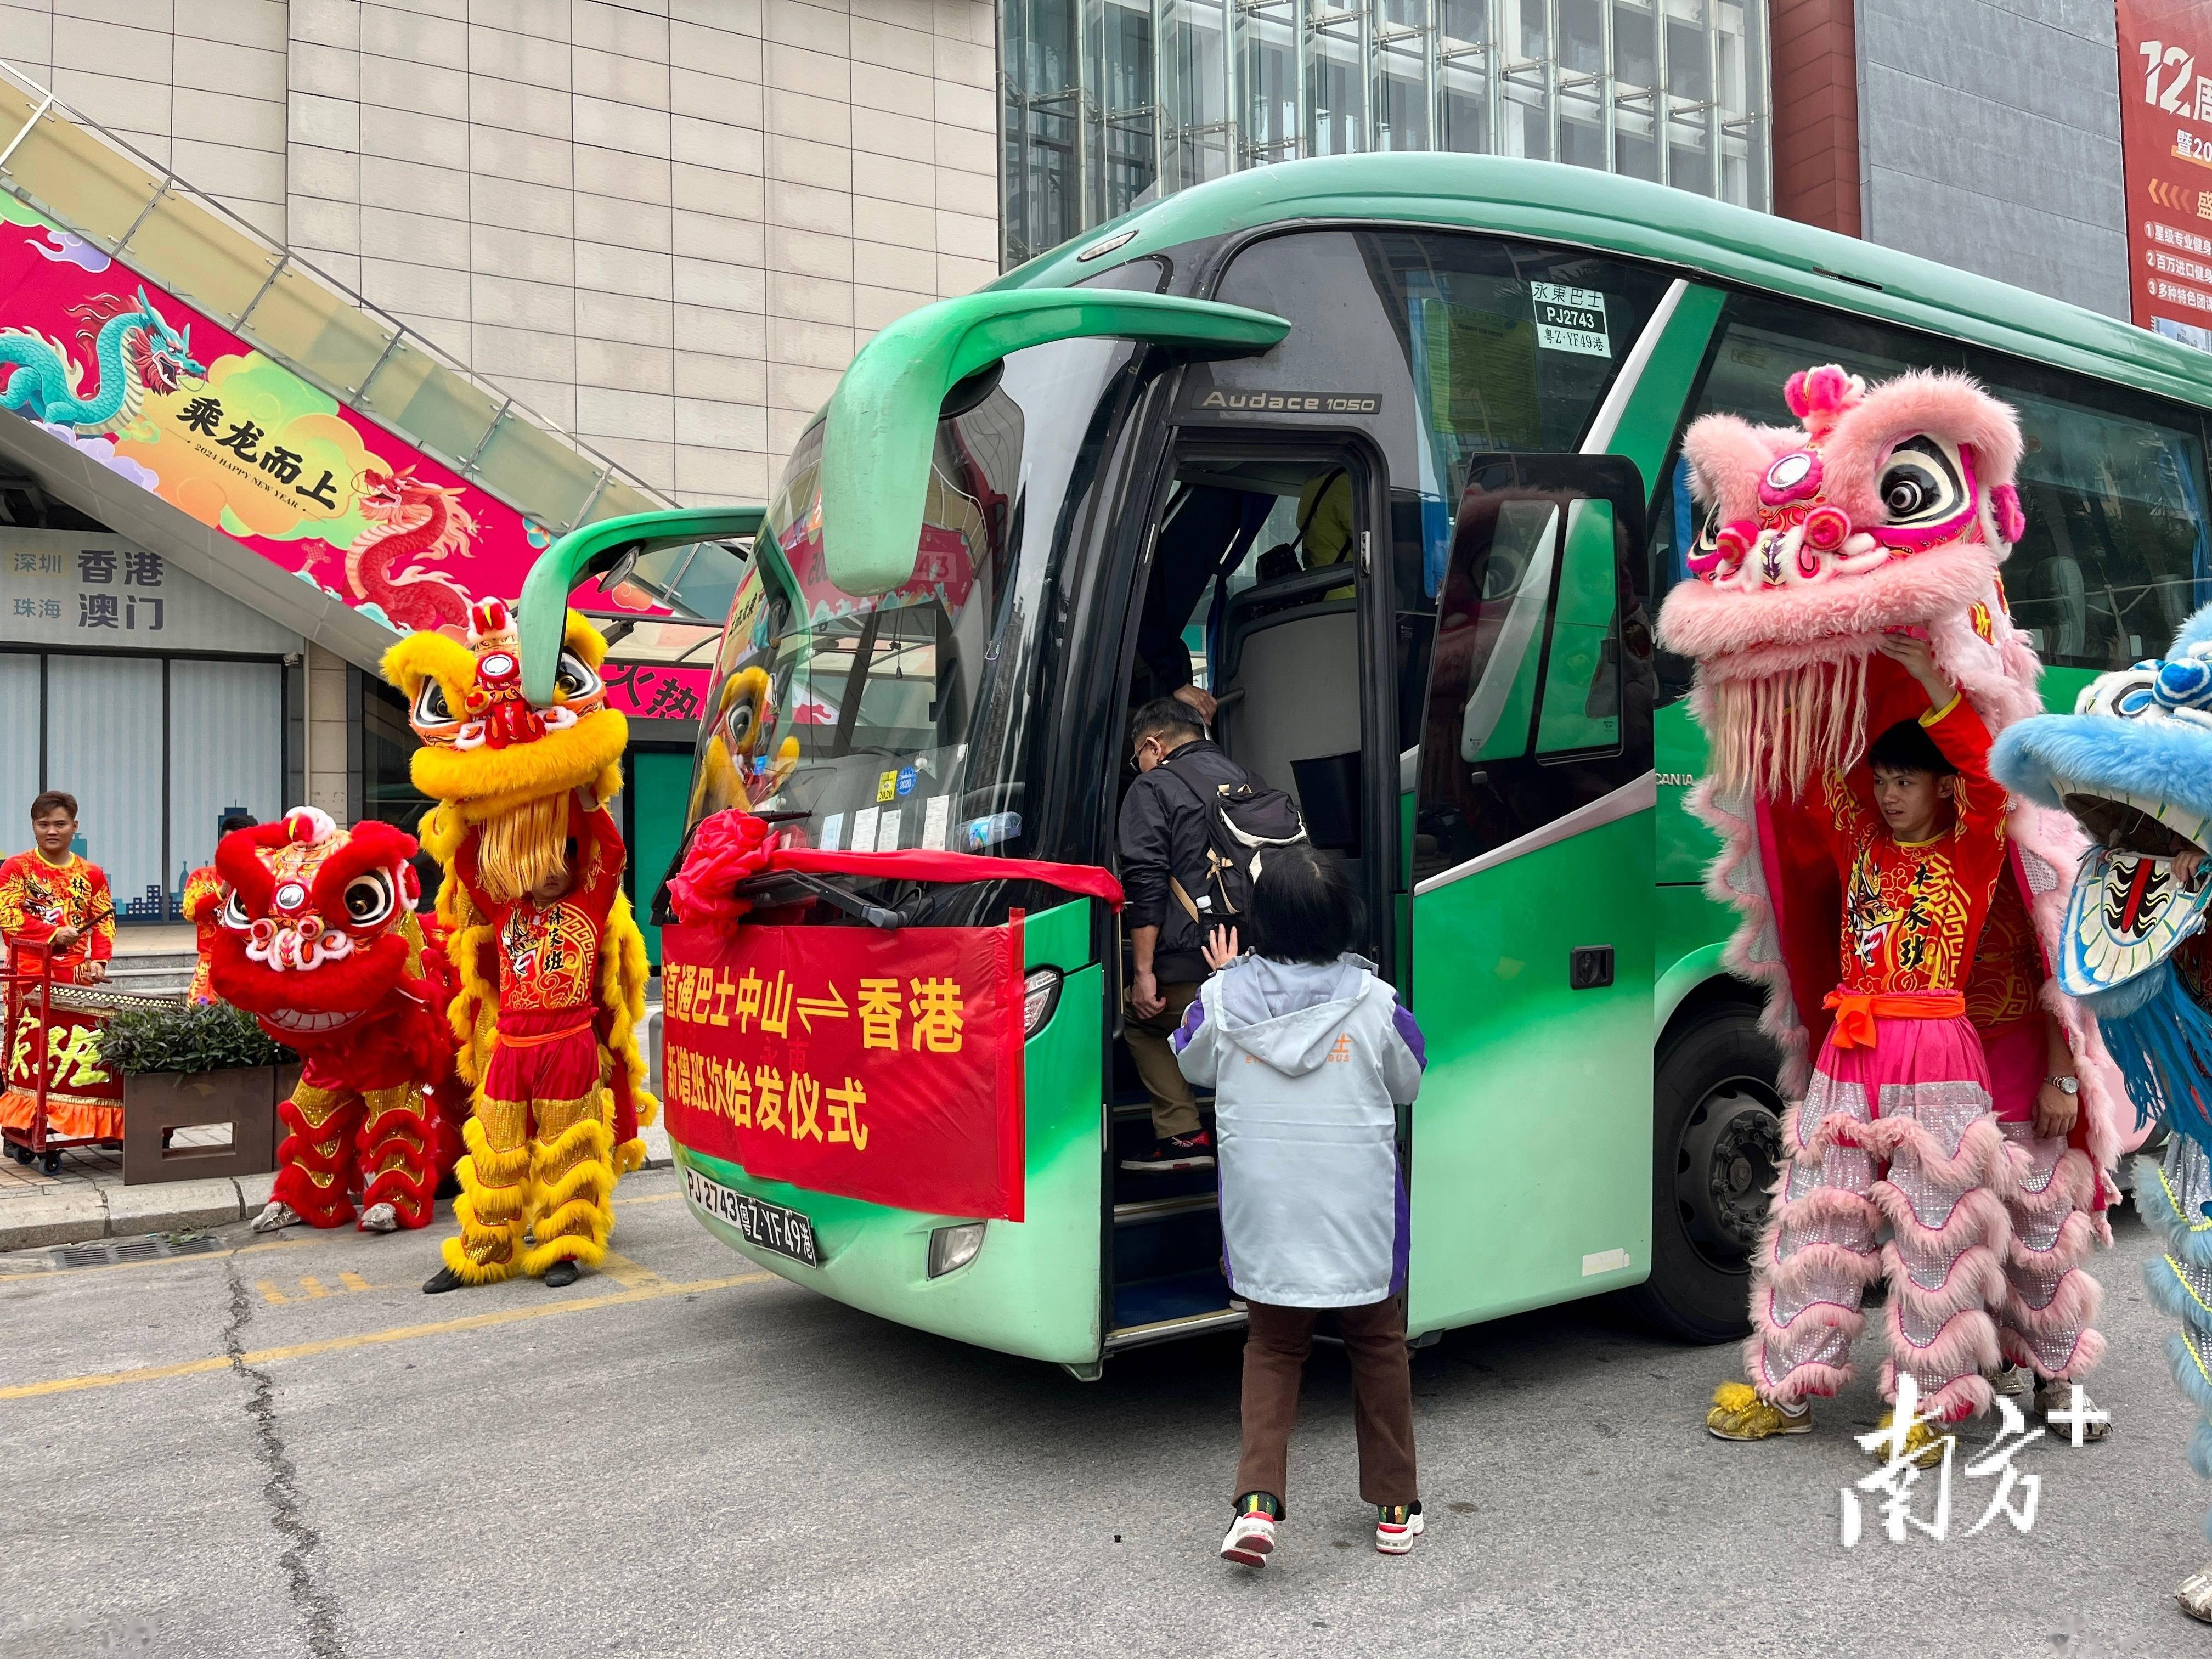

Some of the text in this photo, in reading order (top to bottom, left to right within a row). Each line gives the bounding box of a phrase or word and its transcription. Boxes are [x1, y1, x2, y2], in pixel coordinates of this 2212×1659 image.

[2155, 224, 2211, 256] 星级专业健身
[2156, 253, 2212, 284] 百万进口健身
[1534, 284, 1601, 308] 永東巴士
[1547, 306, 1595, 329] PJ2743
[1544, 328, 1604, 351] 粤Z·YF49港
[1202, 391, 1375, 411] Audace 1050
[176, 397, 337, 510] 乘龙而上
[194, 444, 298, 509] 2024 HAPPY NEW YEAR
[14, 549, 163, 586] 深圳 香港
[13, 593, 163, 630] 珠海 澳门
[878, 790, 893, 800] 2020
[900, 778, 912, 790] 2020
[544, 906, 565, 973] 林家班
[857, 977, 964, 1053] 香港
[1327, 1054, 1350, 1063] BUS
[667, 1041, 868, 1152] 新增班次始发仪式
[686, 1170, 737, 1222] PJ2743
